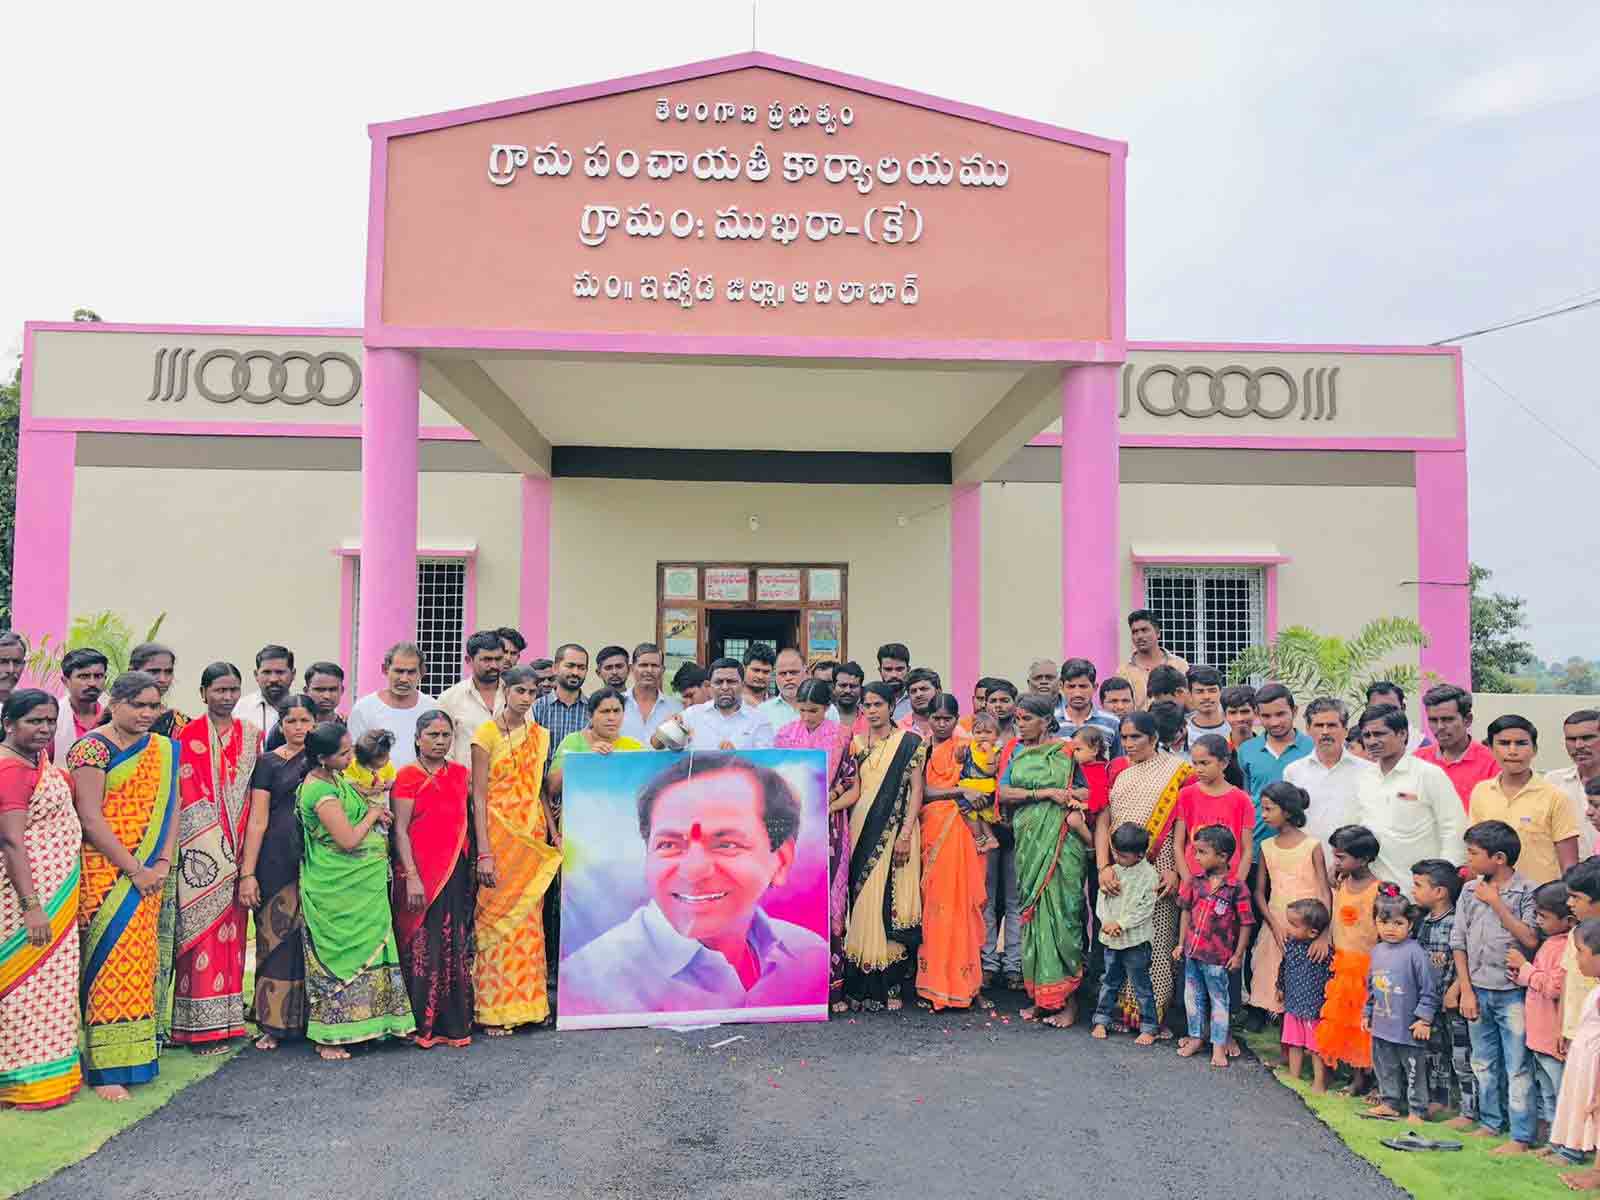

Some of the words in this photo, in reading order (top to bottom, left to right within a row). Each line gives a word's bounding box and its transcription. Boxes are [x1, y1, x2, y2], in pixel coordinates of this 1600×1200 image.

[656, 97, 758, 122] తెలంగాణ
[768, 101, 854, 134] ప్రభుత్వం
[488, 142, 575, 185] గ్రామ
[584, 142, 771, 181] పంచాయతీ
[783, 152, 1009, 194] కార్యాలయము
[579, 202, 704, 246] గ్రామం:
